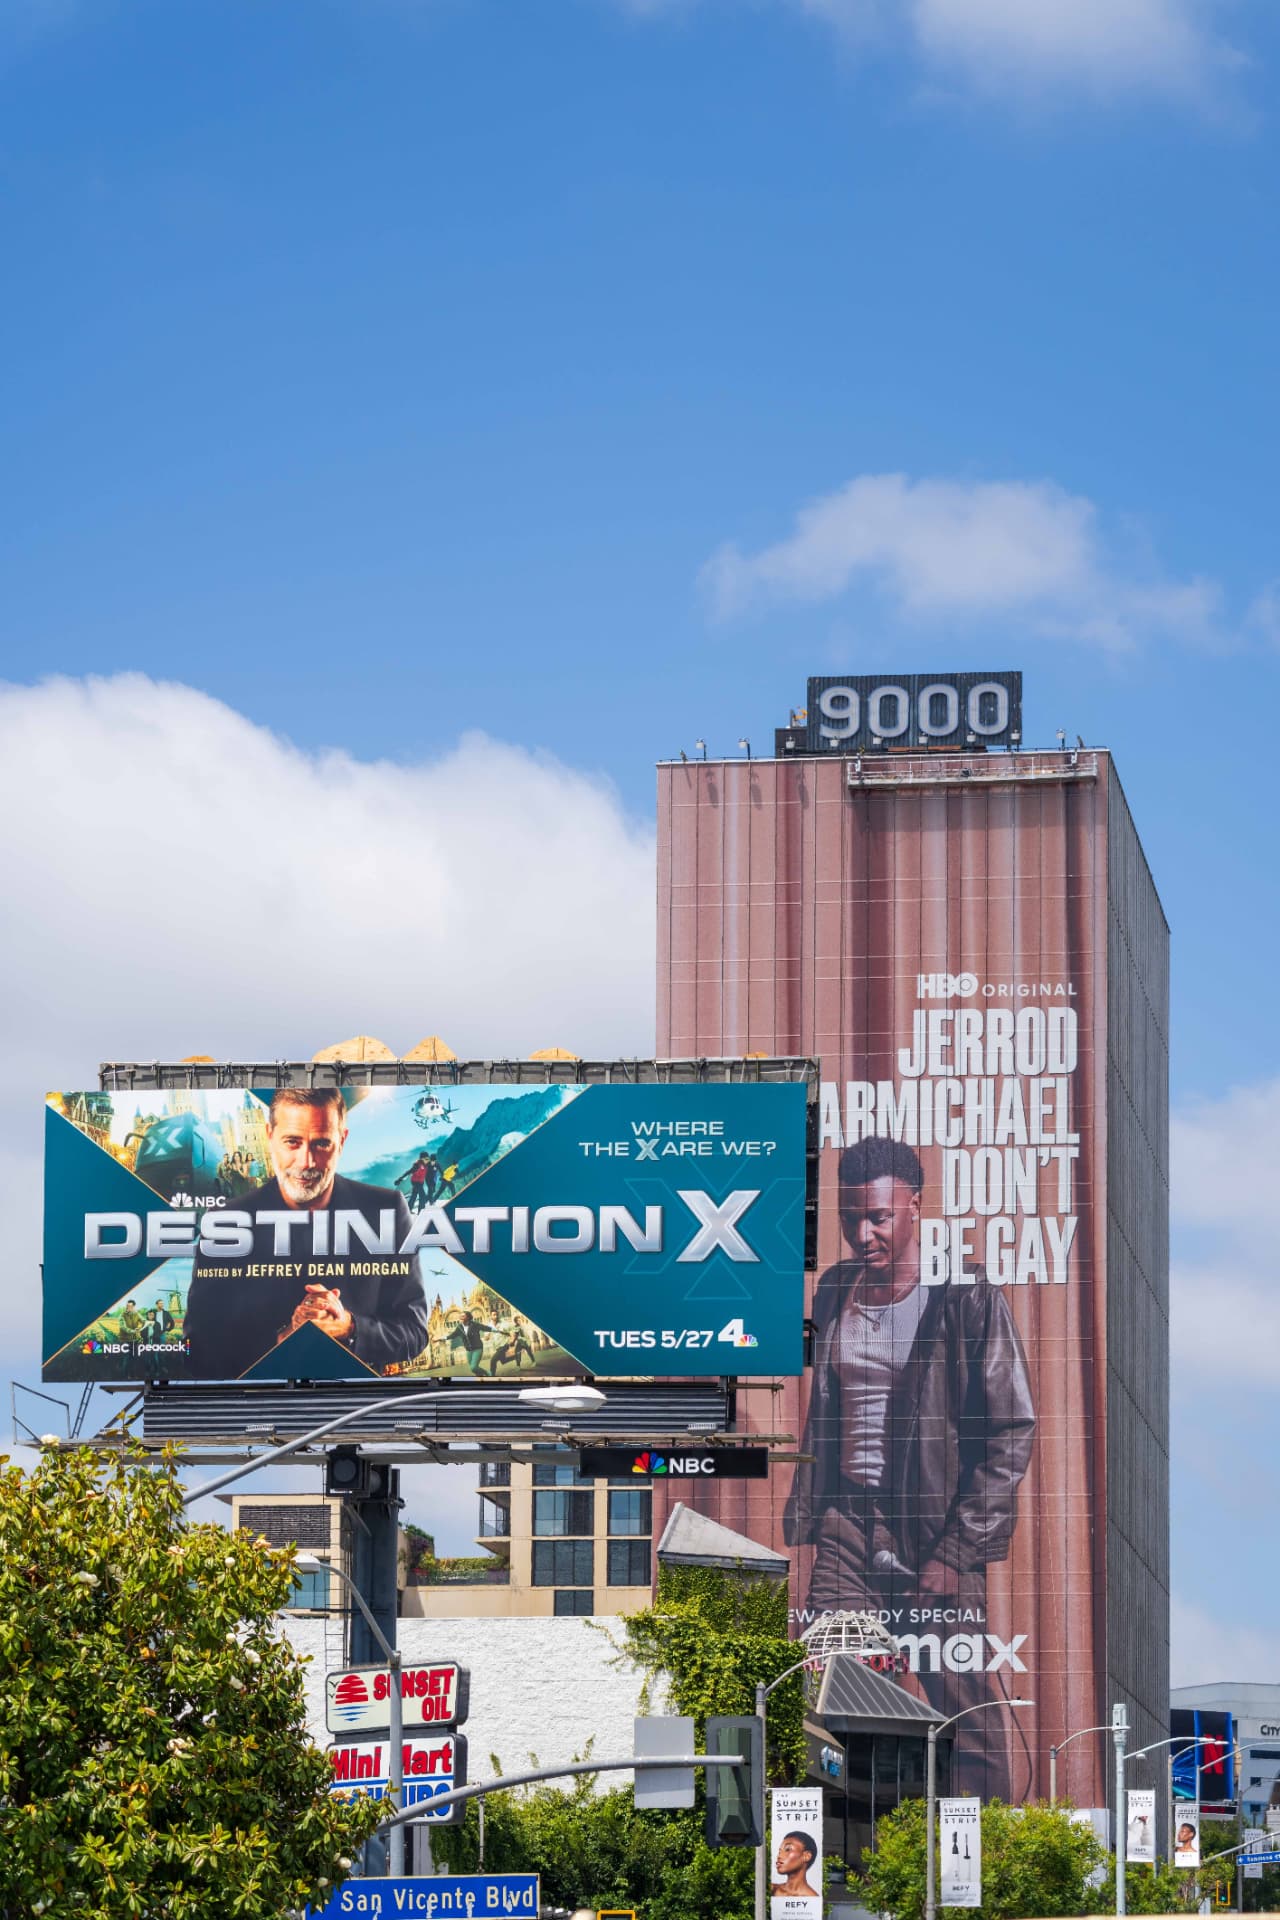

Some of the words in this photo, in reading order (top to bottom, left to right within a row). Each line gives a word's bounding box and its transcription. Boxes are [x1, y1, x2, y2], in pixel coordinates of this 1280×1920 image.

[819, 683, 1008, 739] 9000
[917, 972, 978, 998] HBO
[982, 982, 1077, 997] ORIGINAL
[898, 1006, 1078, 1077] JERROD
[819, 1076, 1080, 1148] ARMICHAEL
[631, 1121, 724, 1136] WHERE
[578, 1141, 630, 1157] THE
[634, 1138, 660, 1161] X
[661, 1141, 713, 1156] ARE
[721, 1141, 776, 1156] WE?
[942, 1147, 1080, 1216] DON'T
[194, 1196, 226, 1208] NBC
[84, 1206, 662, 1260] DESTINATION
[676, 1190, 761, 1262] X
[920, 1217, 977, 1286] BE
[985, 1216, 1078, 1285] GAY
[197, 1268, 229, 1278] HOSTED
[231, 1268, 242, 1277] BY
[245, 1264, 302, 1277] JEFFREY
[308, 1263, 345, 1276] DEAN
[350, 1262, 409, 1275] MORGAN
[594, 1330, 656, 1348] TUES
[660, 1329, 714, 1349] 5/27
[717, 1318, 745, 1347] 4
[103, 1343, 130, 1354] NBC
[137, 1340, 186, 1357] peacock
[668, 1457, 716, 1474] NBC
[788, 1608, 815, 1624] EW
[909, 1608, 986, 1623] SPECIAL
[893, 1633, 1028, 1672] max
[373, 1668, 455, 1701] SNSET
[421, 1696, 452, 1722] OIL
[341, 1891, 382, 1912] San
[393, 1889, 476, 1910] Vicente
[487, 1886, 533, 1908] Blvd
